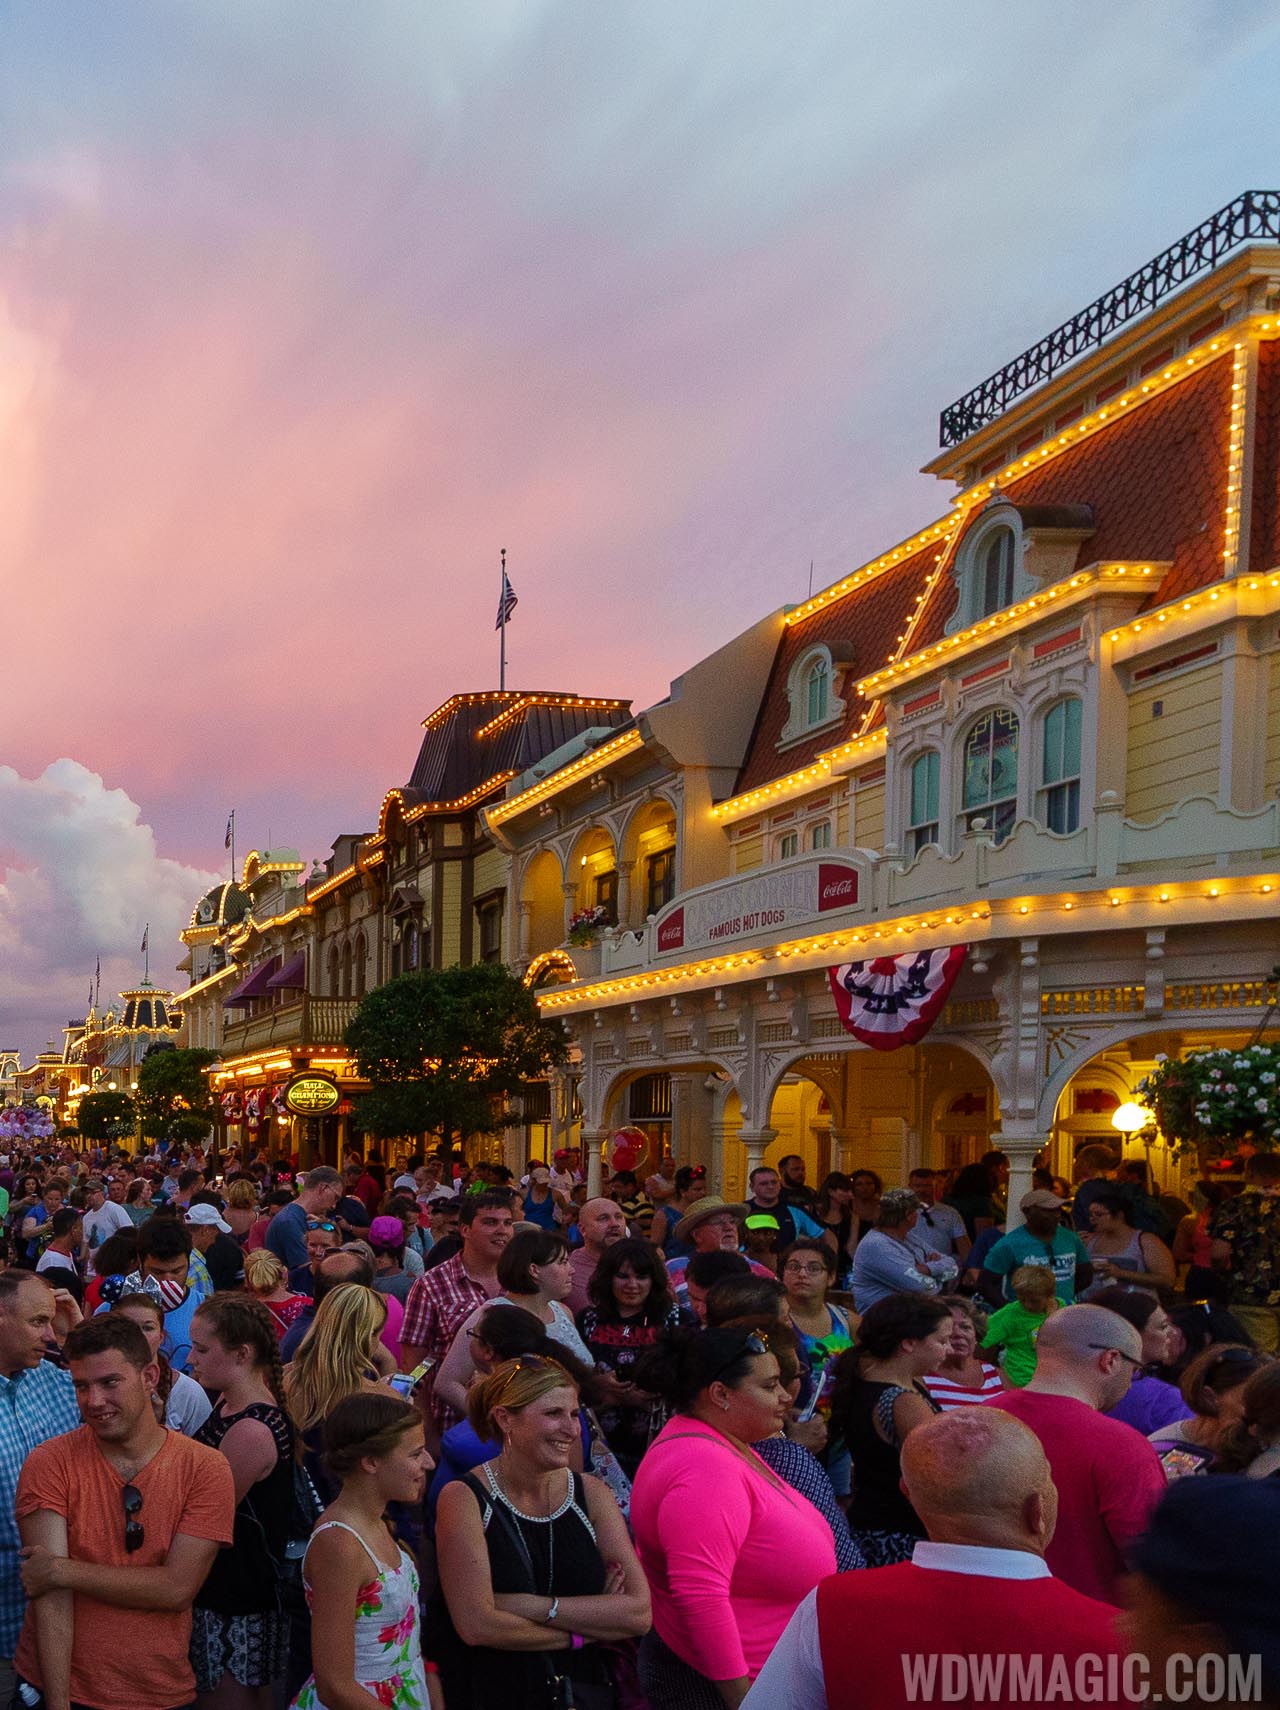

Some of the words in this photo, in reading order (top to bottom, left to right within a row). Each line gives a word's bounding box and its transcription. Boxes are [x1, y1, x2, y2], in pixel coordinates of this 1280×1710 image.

[708, 917, 741, 941] FAMOUS
[743, 912, 760, 931] HOT
[761, 909, 785, 927] DOGS
